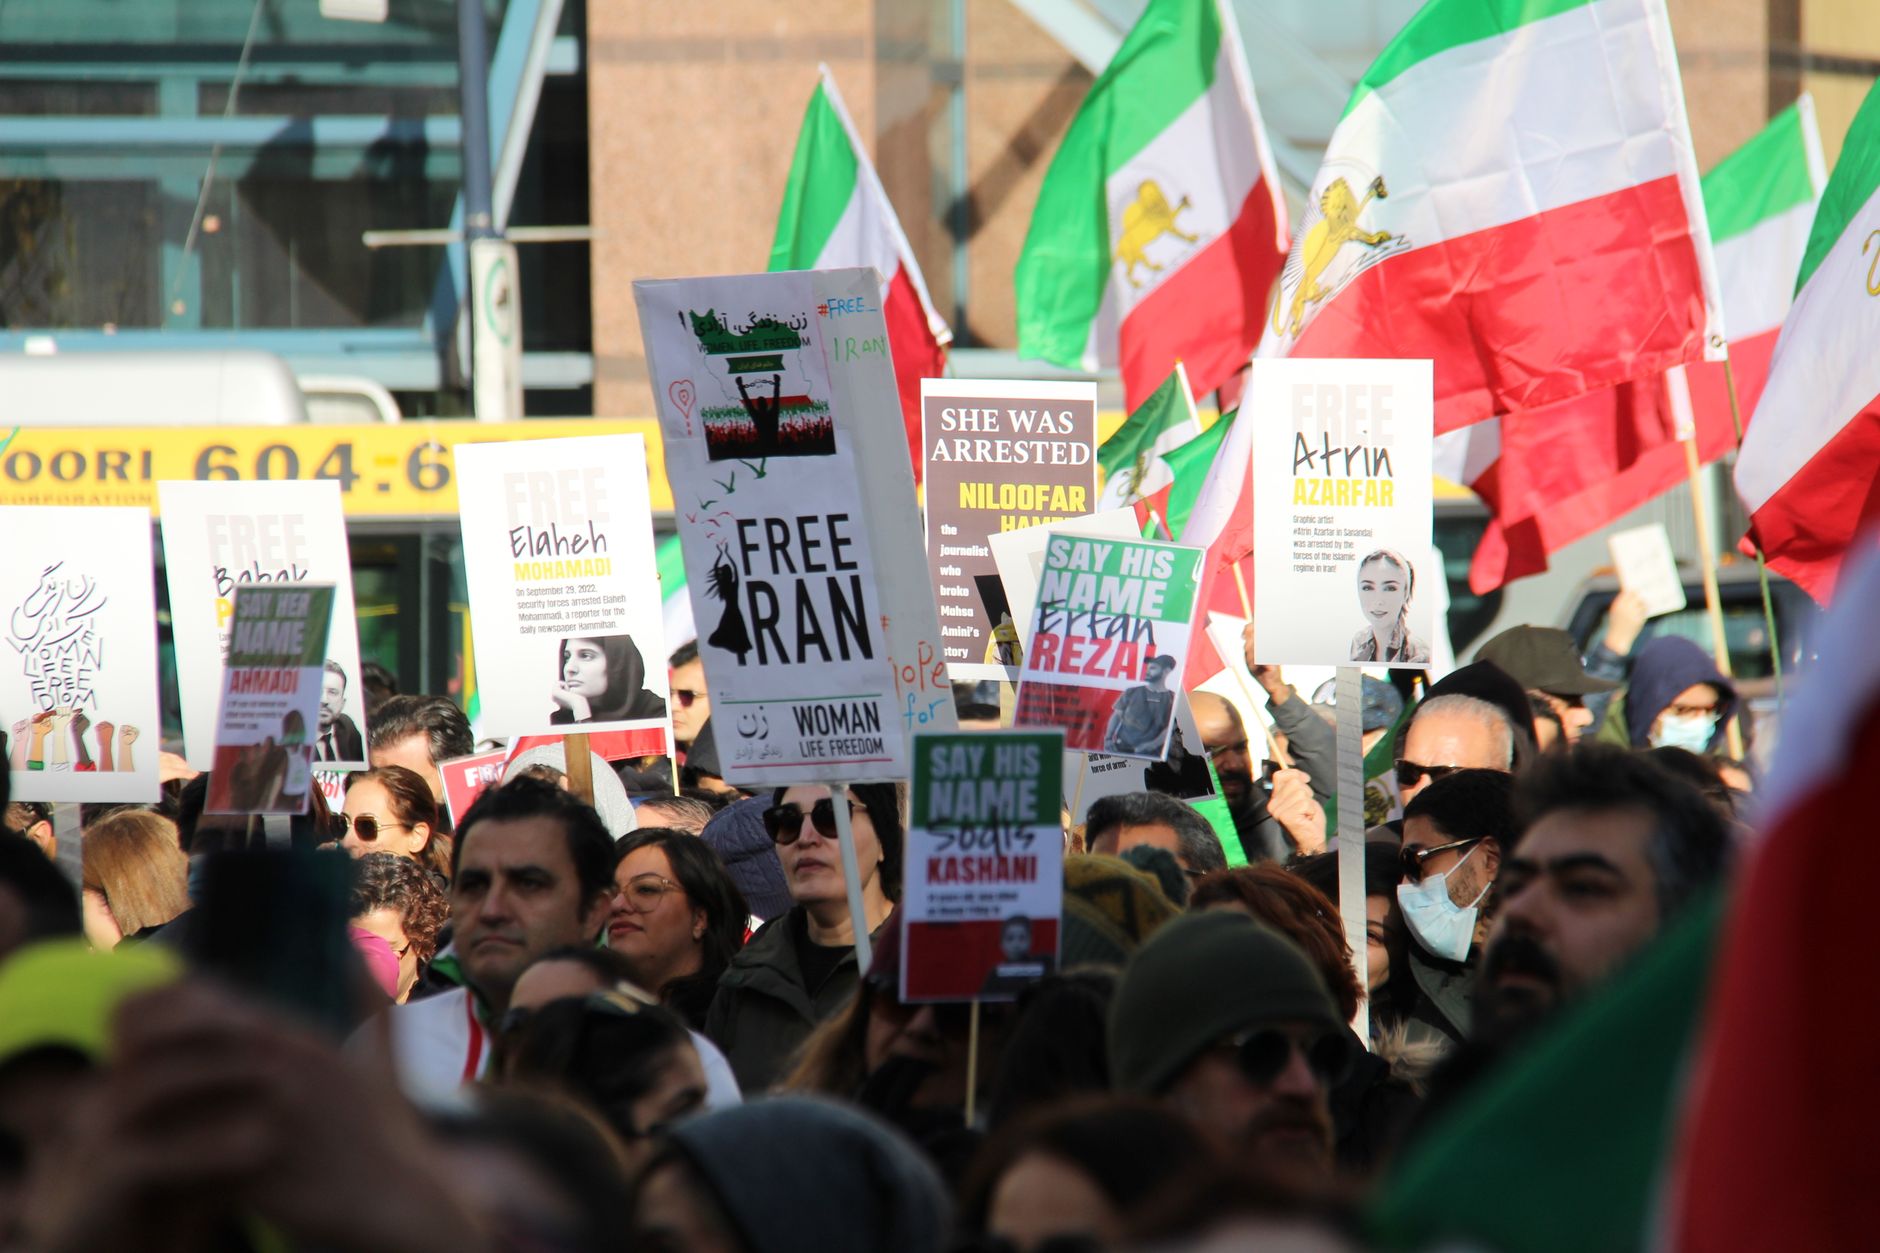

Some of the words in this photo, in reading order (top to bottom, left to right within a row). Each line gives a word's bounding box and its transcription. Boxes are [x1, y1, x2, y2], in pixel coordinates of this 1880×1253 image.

[833, 335, 887, 363] IRAN
[941, 408, 999, 433] SHE
[1007, 409, 1074, 434] WAS
[1291, 384, 1394, 446] FREE
[930, 438, 1090, 465] ARRESTED
[1292, 430, 1393, 477] Atrin
[503, 466, 610, 528] FREE
[959, 482, 1086, 512] NILOOFAR
[1293, 478, 1394, 507] AZARFAR
[206, 514, 310, 570] FREE
[509, 520, 607, 558] Elaheh
[940, 524, 957, 536] the
[736, 513, 858, 576] FREE
[940, 546, 989, 557] journalist
[1293, 552, 1312, 560] forces
[1314, 552, 1320, 560] of
[1321, 552, 1331, 560] the
[1307, 540, 1333, 548] arrested
[1334, 540, 1342, 550] by
[1343, 540, 1354, 548] the
[514, 557, 612, 582] MOHAMADI
[940, 566, 961, 577] who
[1047, 539, 1115, 576] SAY
[1119, 547, 1176, 580] HIS
[238, 593, 273, 618] SAY
[275, 592, 311, 618] HER
[517, 600, 546, 610] security
[546, 598, 570, 608] forces
[571, 596, 601, 607] arrested
[602, 594, 627, 605] Elaheh
[526, 586, 564, 598] September
[940, 586, 969, 597] broke
[1037, 569, 1168, 618] NAME
[571, 609, 600, 620] reporter
[601, 607, 612, 617] for
[613, 606, 625, 616] the
[735, 575, 874, 667] RAN
[940, 606, 974, 617] Mahsa
[1038, 598, 1155, 646] Erfan
[234, 620, 306, 656] NAME
[537, 623, 577, 634] newspaper
[941, 626, 979, 637] Amini's
[1028, 631, 1157, 682] REZAI
[229, 669, 299, 695] AHMADI
[737, 705, 769, 740] زن
[792, 701, 881, 738] WOMAN
[902, 692, 947, 731] for
[799, 739, 825, 758] LIFE
[828, 738, 885, 757] FREEDOM
[929, 744, 985, 779] SAY
[993, 743, 1041, 779] HIS
[1091, 763, 1107, 774] force
[928, 779, 1038, 822] NAME
[927, 855, 1037, 885] KASHANI
